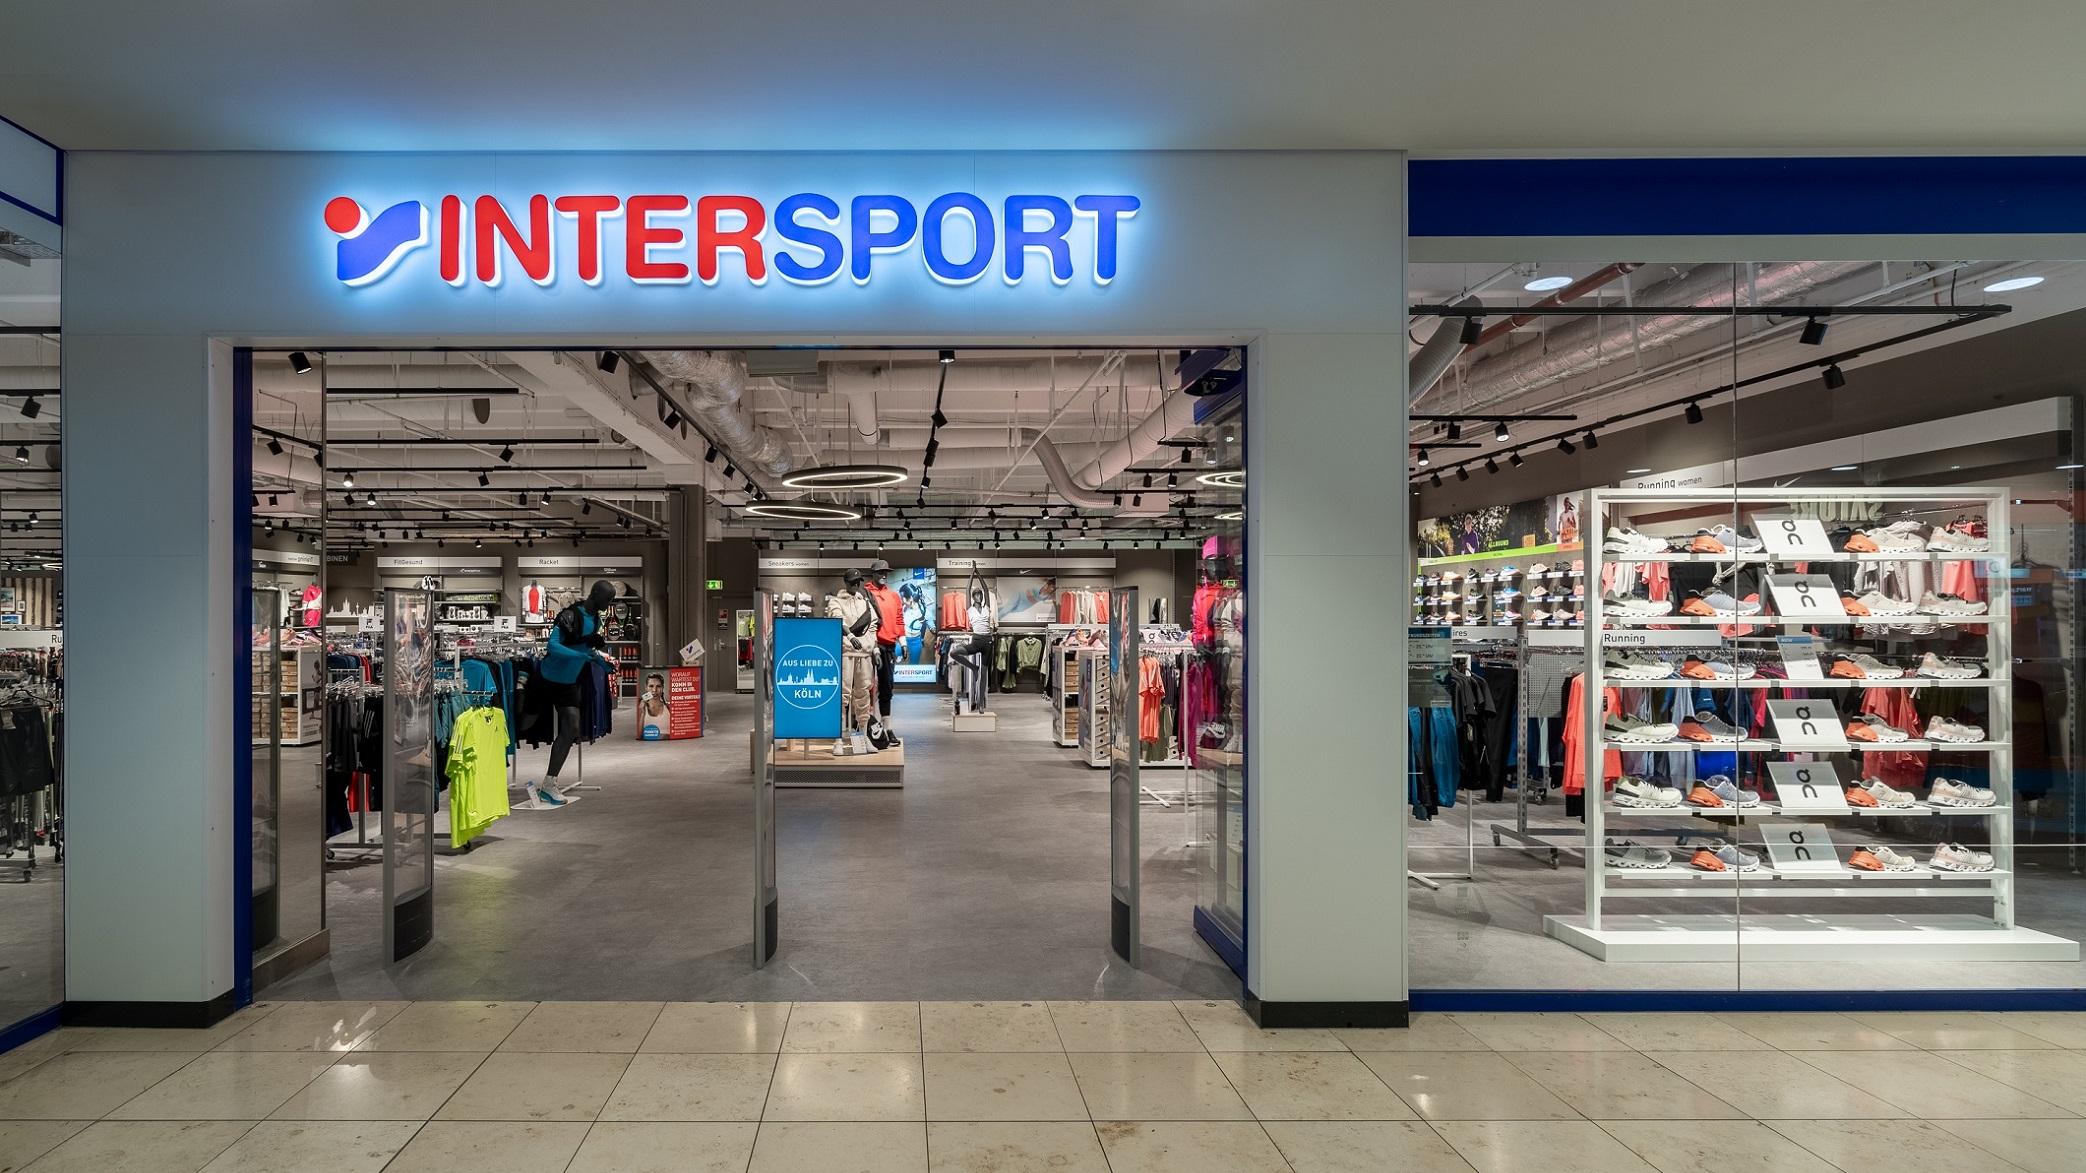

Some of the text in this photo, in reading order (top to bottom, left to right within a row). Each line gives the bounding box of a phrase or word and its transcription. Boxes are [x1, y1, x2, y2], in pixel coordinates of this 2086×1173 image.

[440, 192, 1141, 284] INTERSPORT
[1678, 477, 1702, 486] women
[1604, 633, 1646, 645] Running
[782, 659, 833, 667] AUS LIEBE ZU
[794, 688, 822, 699] KÖLN
